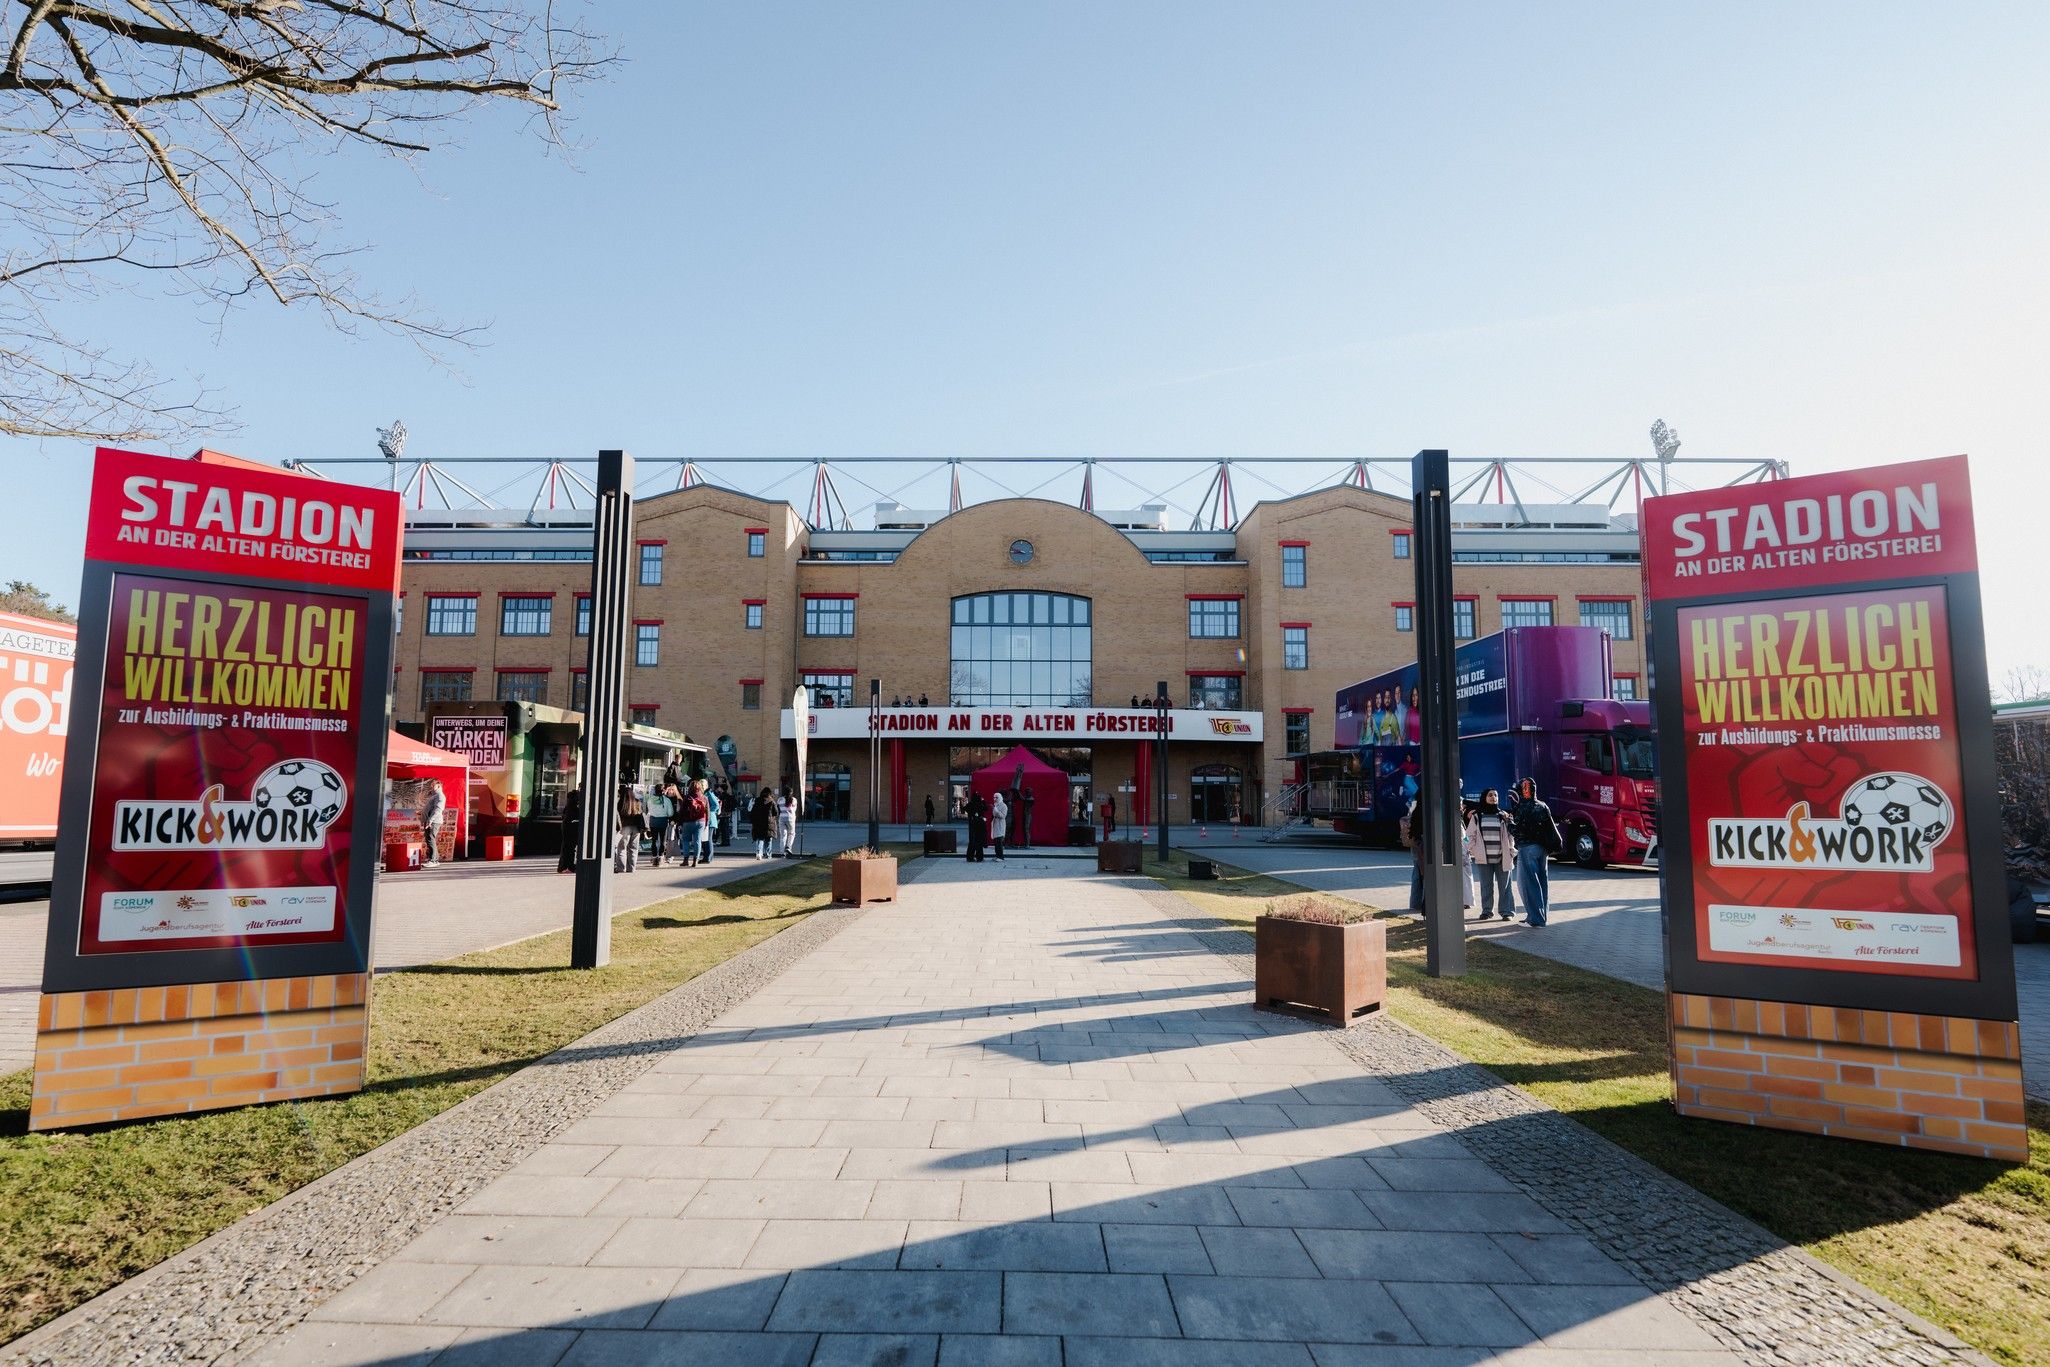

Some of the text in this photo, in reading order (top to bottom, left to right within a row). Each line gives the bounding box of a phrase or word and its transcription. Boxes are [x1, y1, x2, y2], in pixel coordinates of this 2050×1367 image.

[121, 476, 375, 550] STADION
[1672, 483, 1941, 557] STADION
[117, 525, 371, 570] AN DER ALTEN FÖRSTEREI
[1675, 534, 1942, 577] AN DER ALTEN FÖRSTEREI
[126, 589, 355, 668] HERZLICH
[1691, 600, 1934, 680] HERZLICH
[124, 655, 350, 711] WILLKOMMEN
[1460, 673, 1469, 686] IN
[1470, 669, 1485, 683] DIE
[1695, 670, 1938, 723] WILLKOMMEN
[118, 706, 348, 732] zur Ausbildungs- & Praktikumsmesse
[436, 719, 505, 727] UNTERWEGS, UM DEINE
[868, 712, 1174, 732] STADION AN DER ALTEN FÖRSTEREI
[434, 727, 504, 749] STÄRKEN
[1698, 725, 1941, 746] zur Ausbildungs- & Praktikumsmesse
[26, 752, 61, 777] Wo
[113, 898, 154, 907] FORUM
[139, 922, 225, 933] Jugendberufsagentur
[246, 917, 303, 930] Alte Försterei
[1719, 911, 1756, 921] FORUM
[1854, 946, 1919, 955] Alte Försterei
